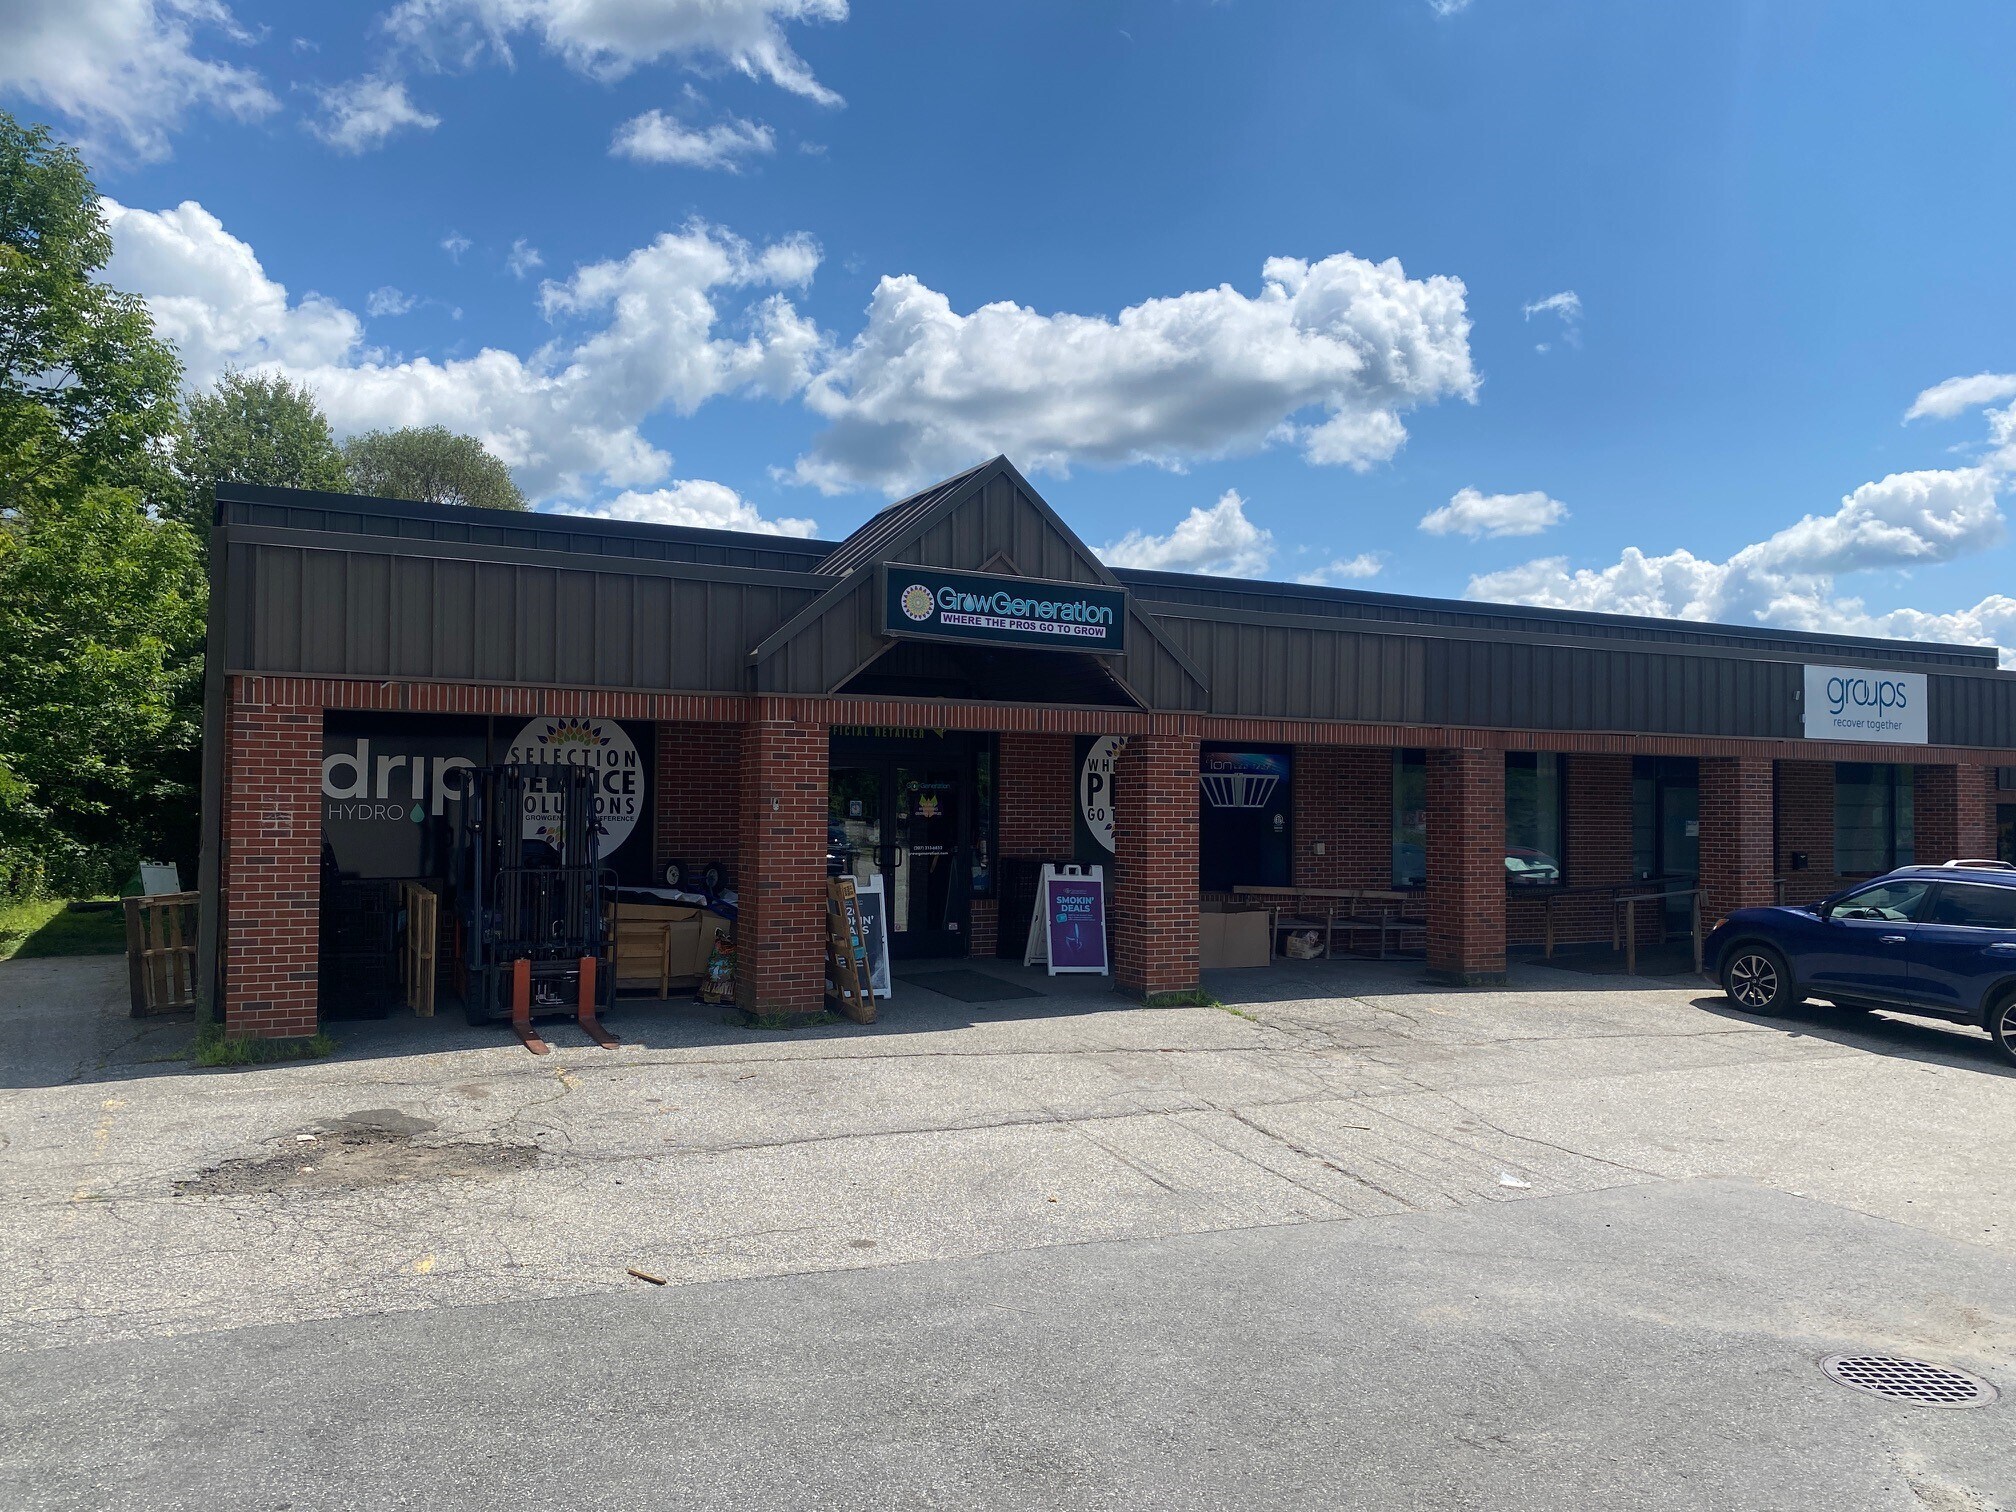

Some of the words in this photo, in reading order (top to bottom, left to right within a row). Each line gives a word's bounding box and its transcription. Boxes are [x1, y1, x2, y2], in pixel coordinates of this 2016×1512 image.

[937, 586, 1113, 625] GrowGeneration
[942, 613, 982, 626] WHERE
[985, 617, 1006, 628] THE
[1009, 620, 1036, 631] PROS
[1039, 622, 1054, 632] GO
[1057, 624, 1071, 634] TO
[1074, 625, 1104, 637] GROW
[1826, 677, 1907, 717] groups
[874, 727, 925, 738] RETAILER
[1833, 717, 1865, 728] recover
[1866, 719, 1902, 732] together
[510, 746, 636, 768] SELECTION
[321, 738, 477, 816] drip
[328, 803, 404, 821] HYDRO
[523, 795, 635, 815] OLUONS
[1087, 807, 1105, 821] GO
[1056, 896, 1095, 905] SMOKIN'
[1061, 904, 1091, 912] DEALS
